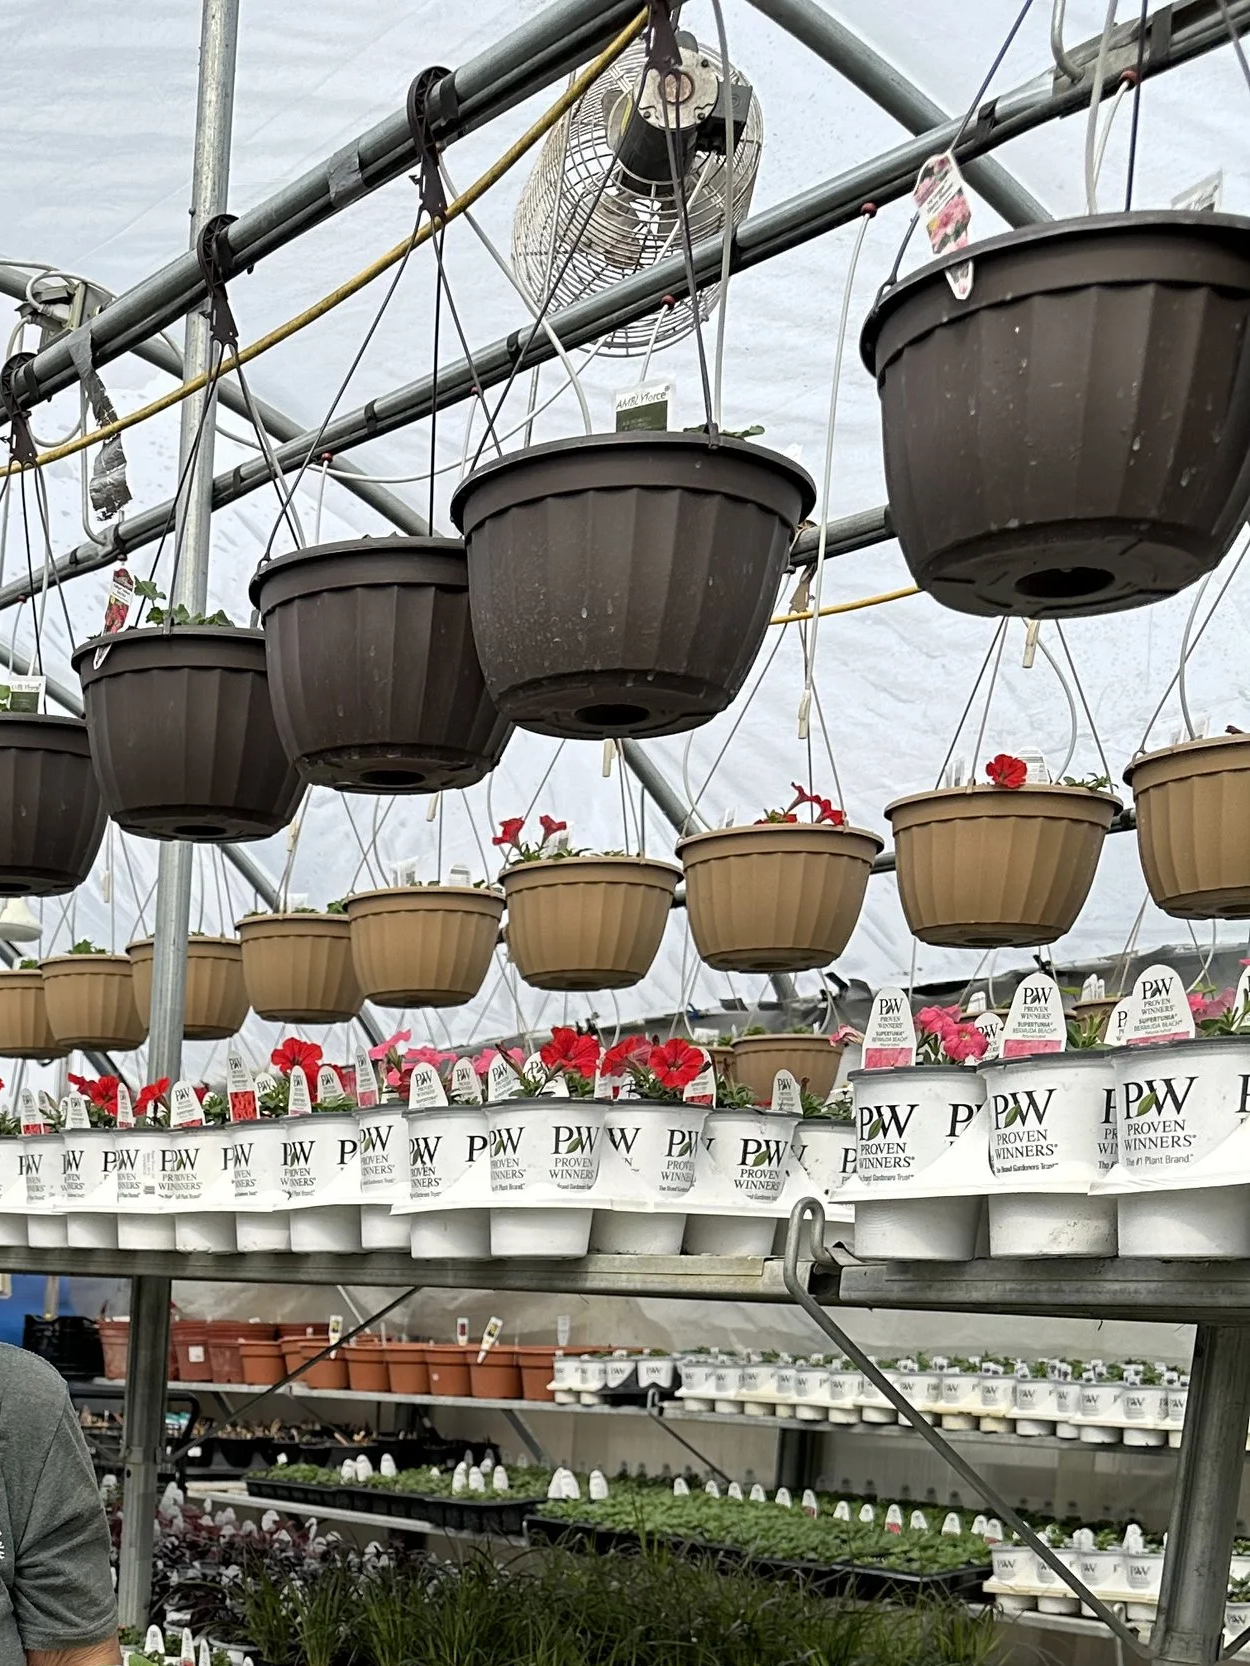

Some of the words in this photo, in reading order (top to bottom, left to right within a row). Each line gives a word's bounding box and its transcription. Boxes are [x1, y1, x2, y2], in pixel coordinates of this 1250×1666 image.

[1023, 987, 1053, 1005] PW
[1141, 977, 1174, 1000] PW
[878, 998, 904, 1015] PW
[1143, 998, 1171, 1008] PROVEN
[1123, 1076, 1199, 1120] PW
[992, 1088, 1058, 1130] PW
[859, 1104, 920, 1141] PW
[1127, 1119, 1186, 1136] PROVEN
[551, 1126, 600, 1155] PW
[996, 1129, 1048, 1146] PROVEN
[1124, 1134, 1192, 1151] WINNERS
[737, 1139, 788, 1168] PW
[860, 1142, 907, 1156] PROVEN
[994, 1143, 1054, 1160] WINNERS
[555, 1158, 593, 1168] PROVEN
[1126, 1157, 1135, 1166] The
[1145, 1155, 1163, 1165] Plant
[740, 1169, 779, 1179] PROVEN
